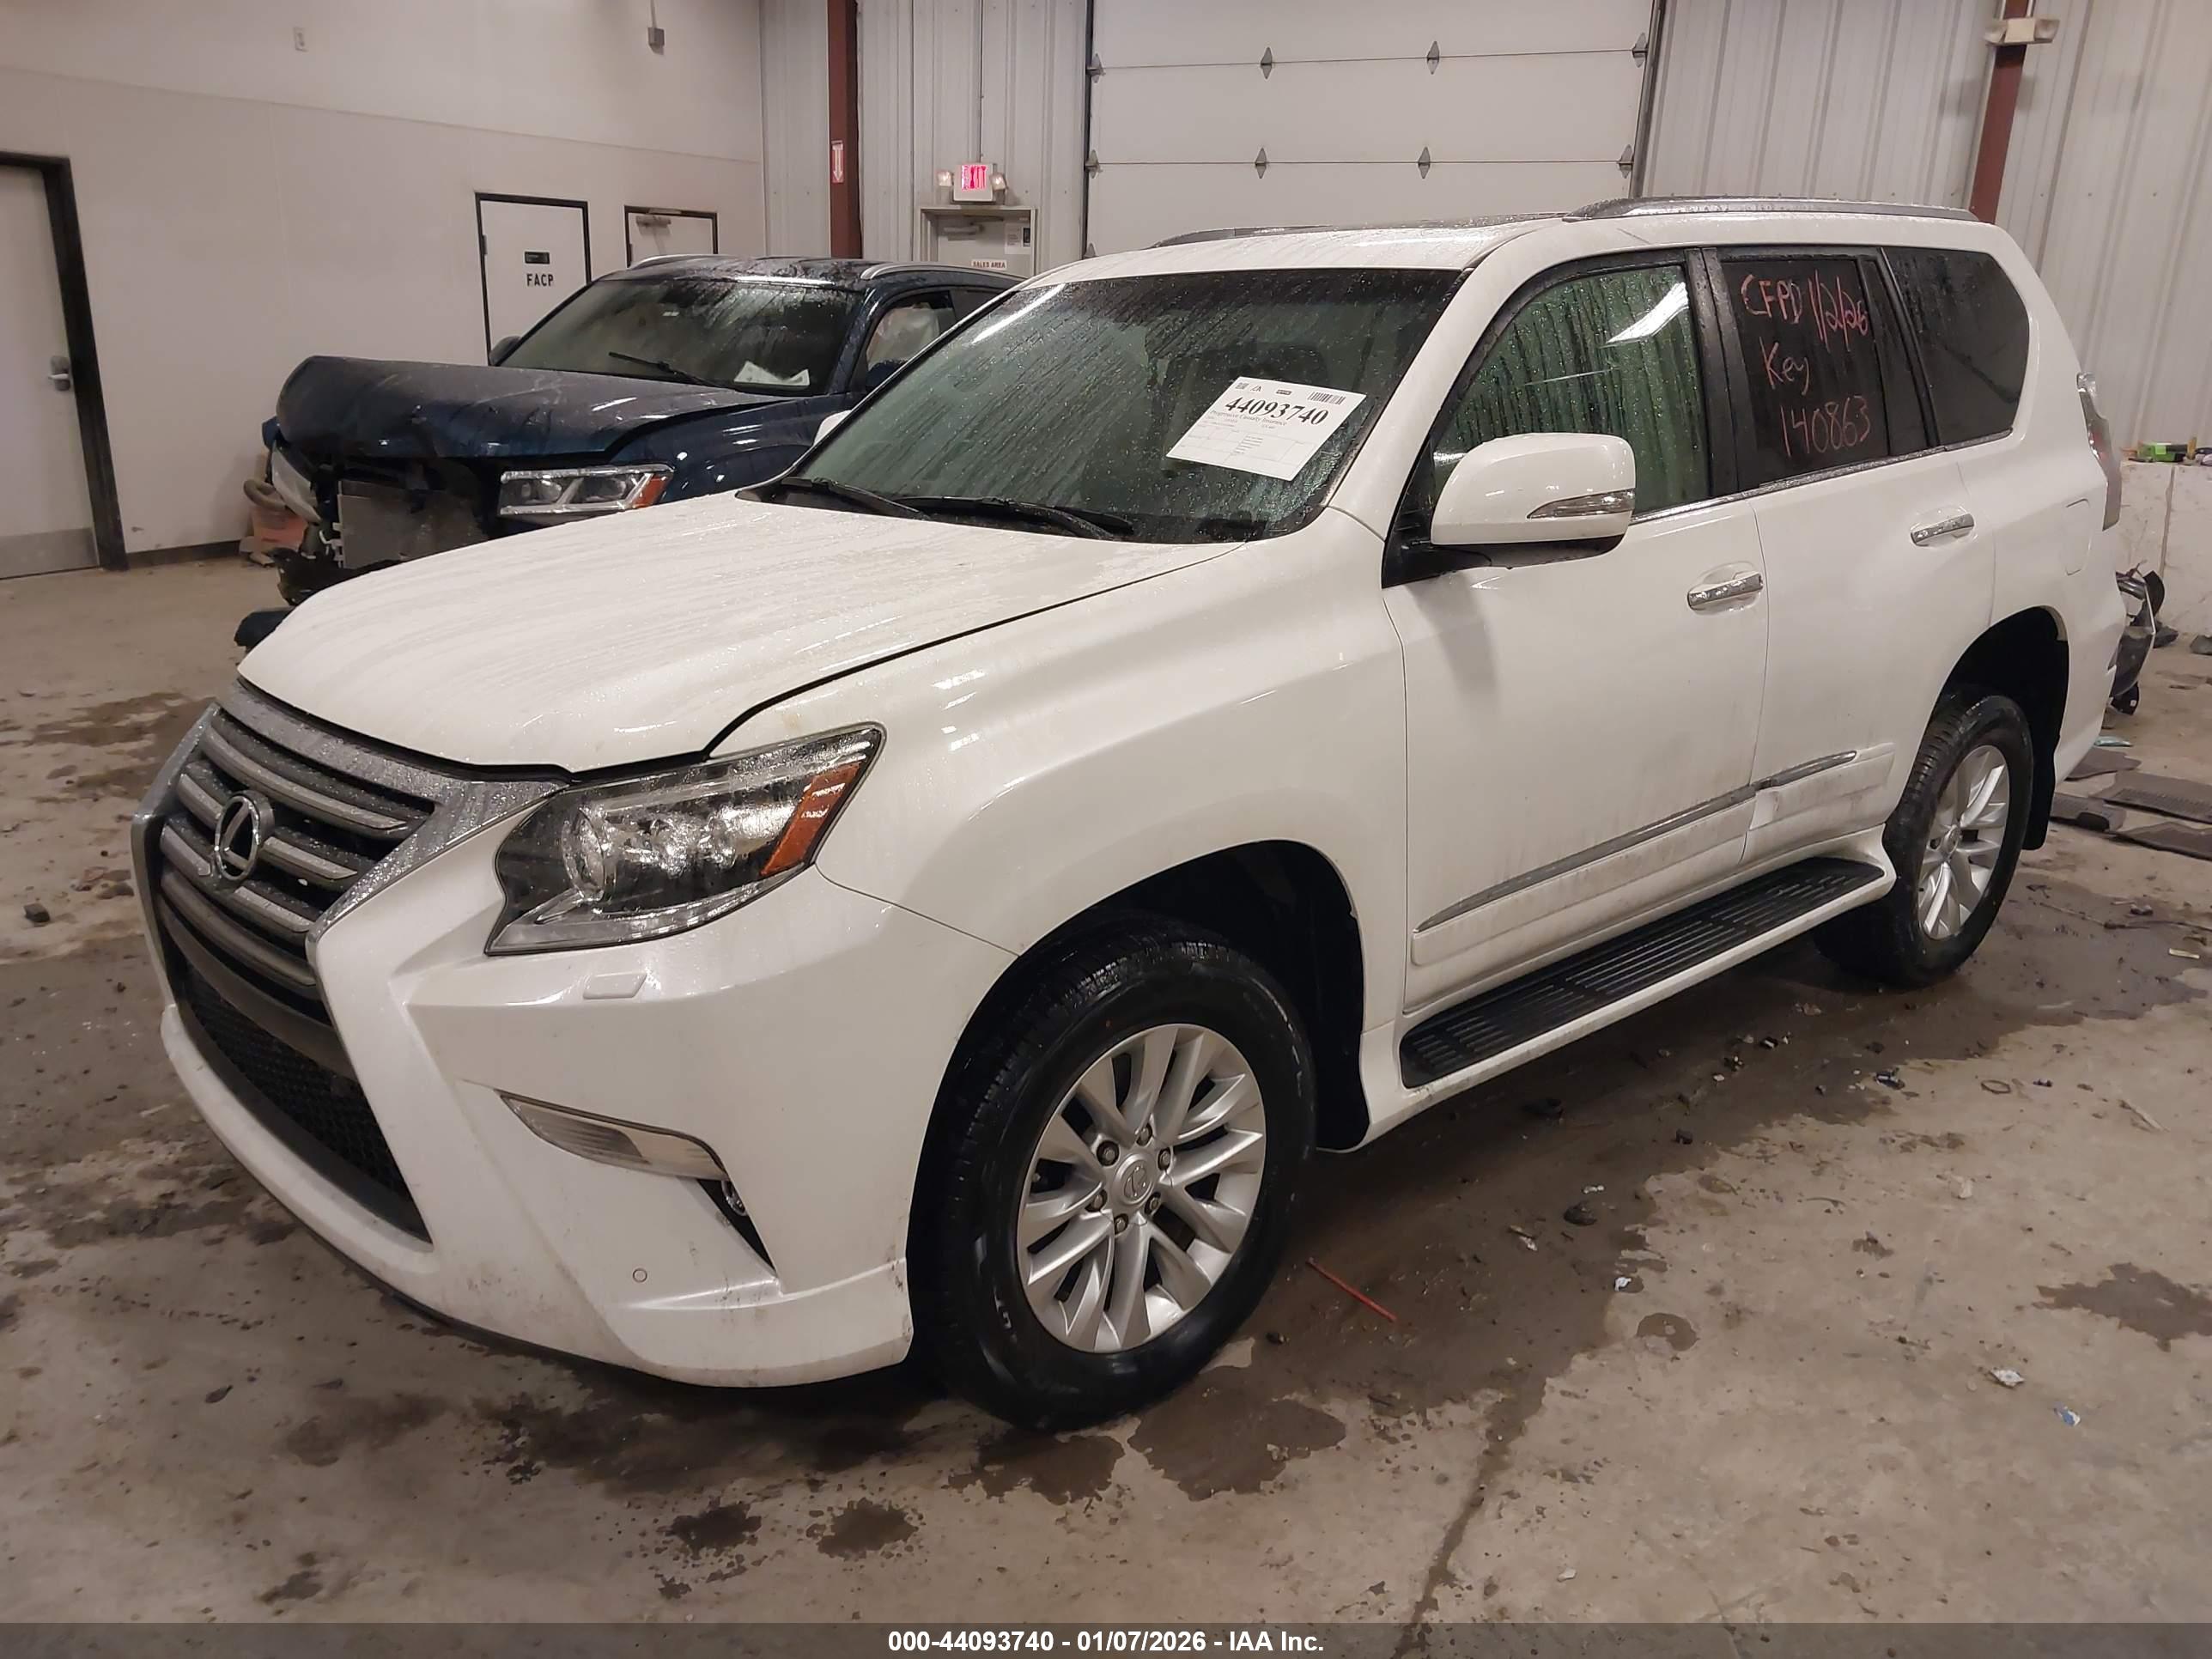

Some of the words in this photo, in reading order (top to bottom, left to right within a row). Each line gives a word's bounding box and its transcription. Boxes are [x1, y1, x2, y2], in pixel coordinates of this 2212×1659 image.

[526, 273, 554, 287] FACP
[1759, 336, 1810, 395] Key
[1225, 397, 1329, 425] 44093740
[1780, 395, 1870, 458] 140863
